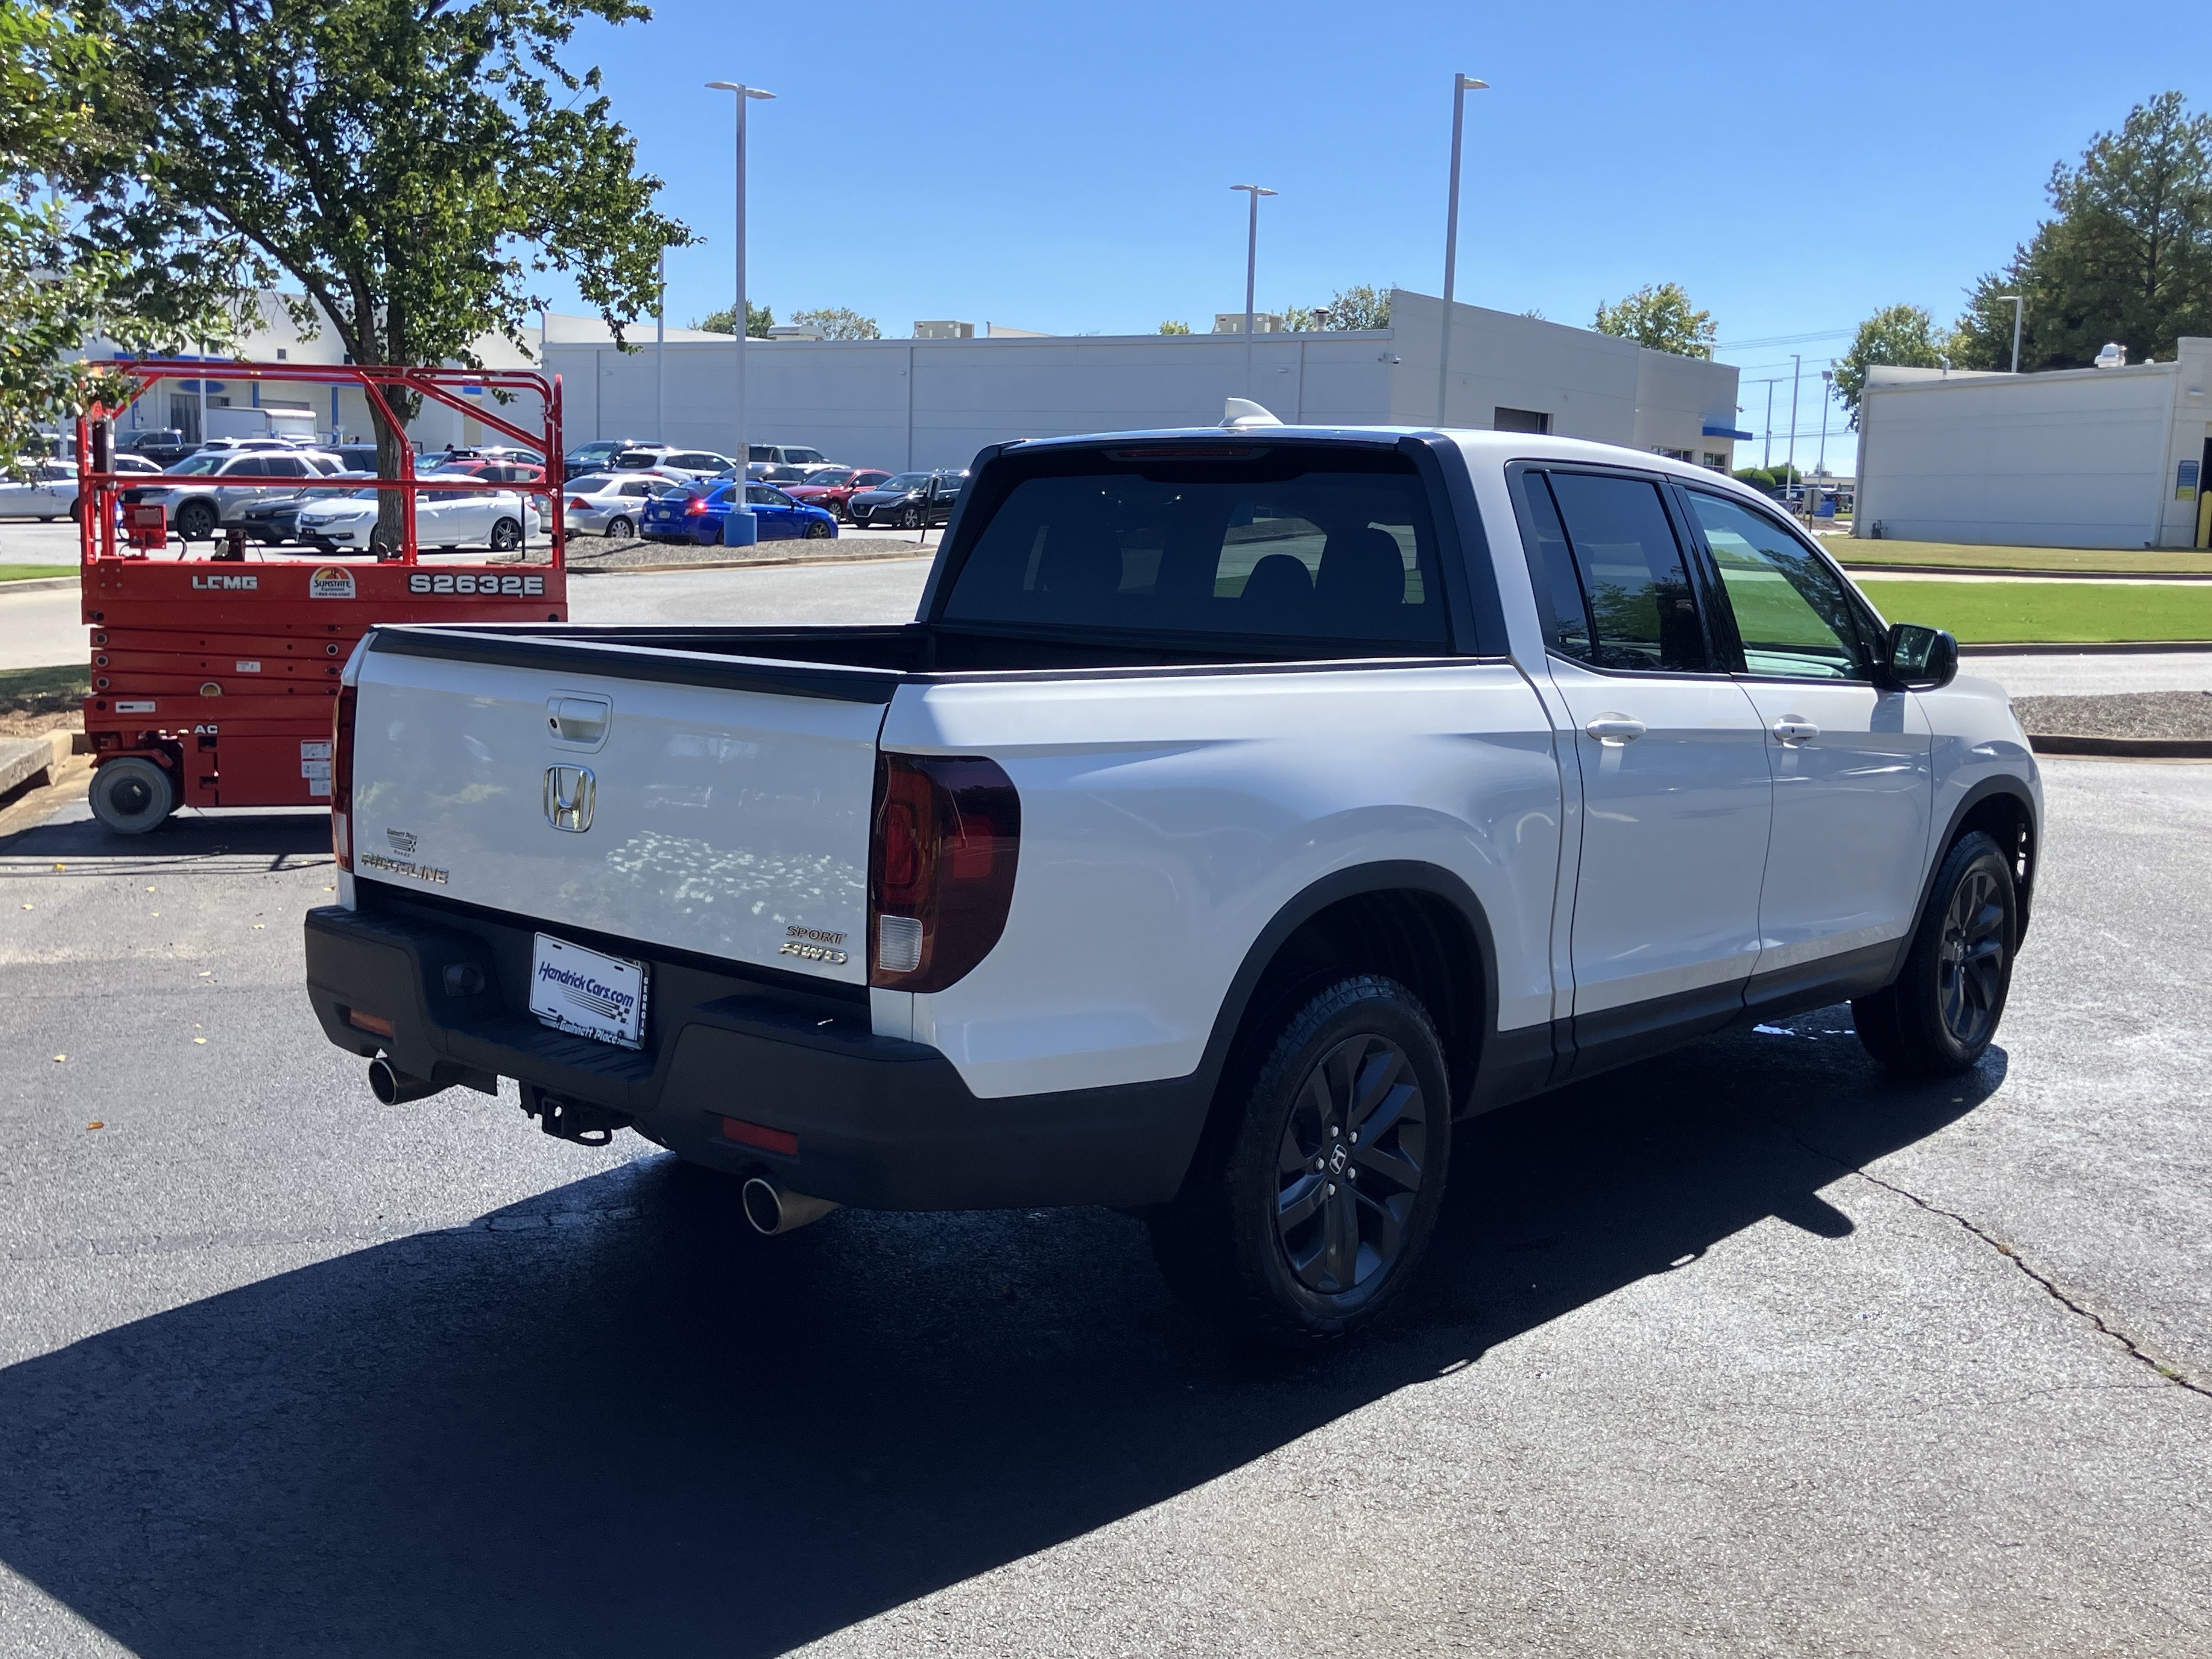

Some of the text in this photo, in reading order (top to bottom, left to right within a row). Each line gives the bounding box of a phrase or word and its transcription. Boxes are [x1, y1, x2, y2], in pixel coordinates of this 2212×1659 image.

[410, 574, 544, 594] S2632E
[194, 725, 218, 734] AC
[361, 851, 449, 884] RIDGELINE
[786, 925, 847, 944] SPORT
[778, 941, 848, 964] AWD
[559, 1020, 618, 1044] Gwinnett Place
